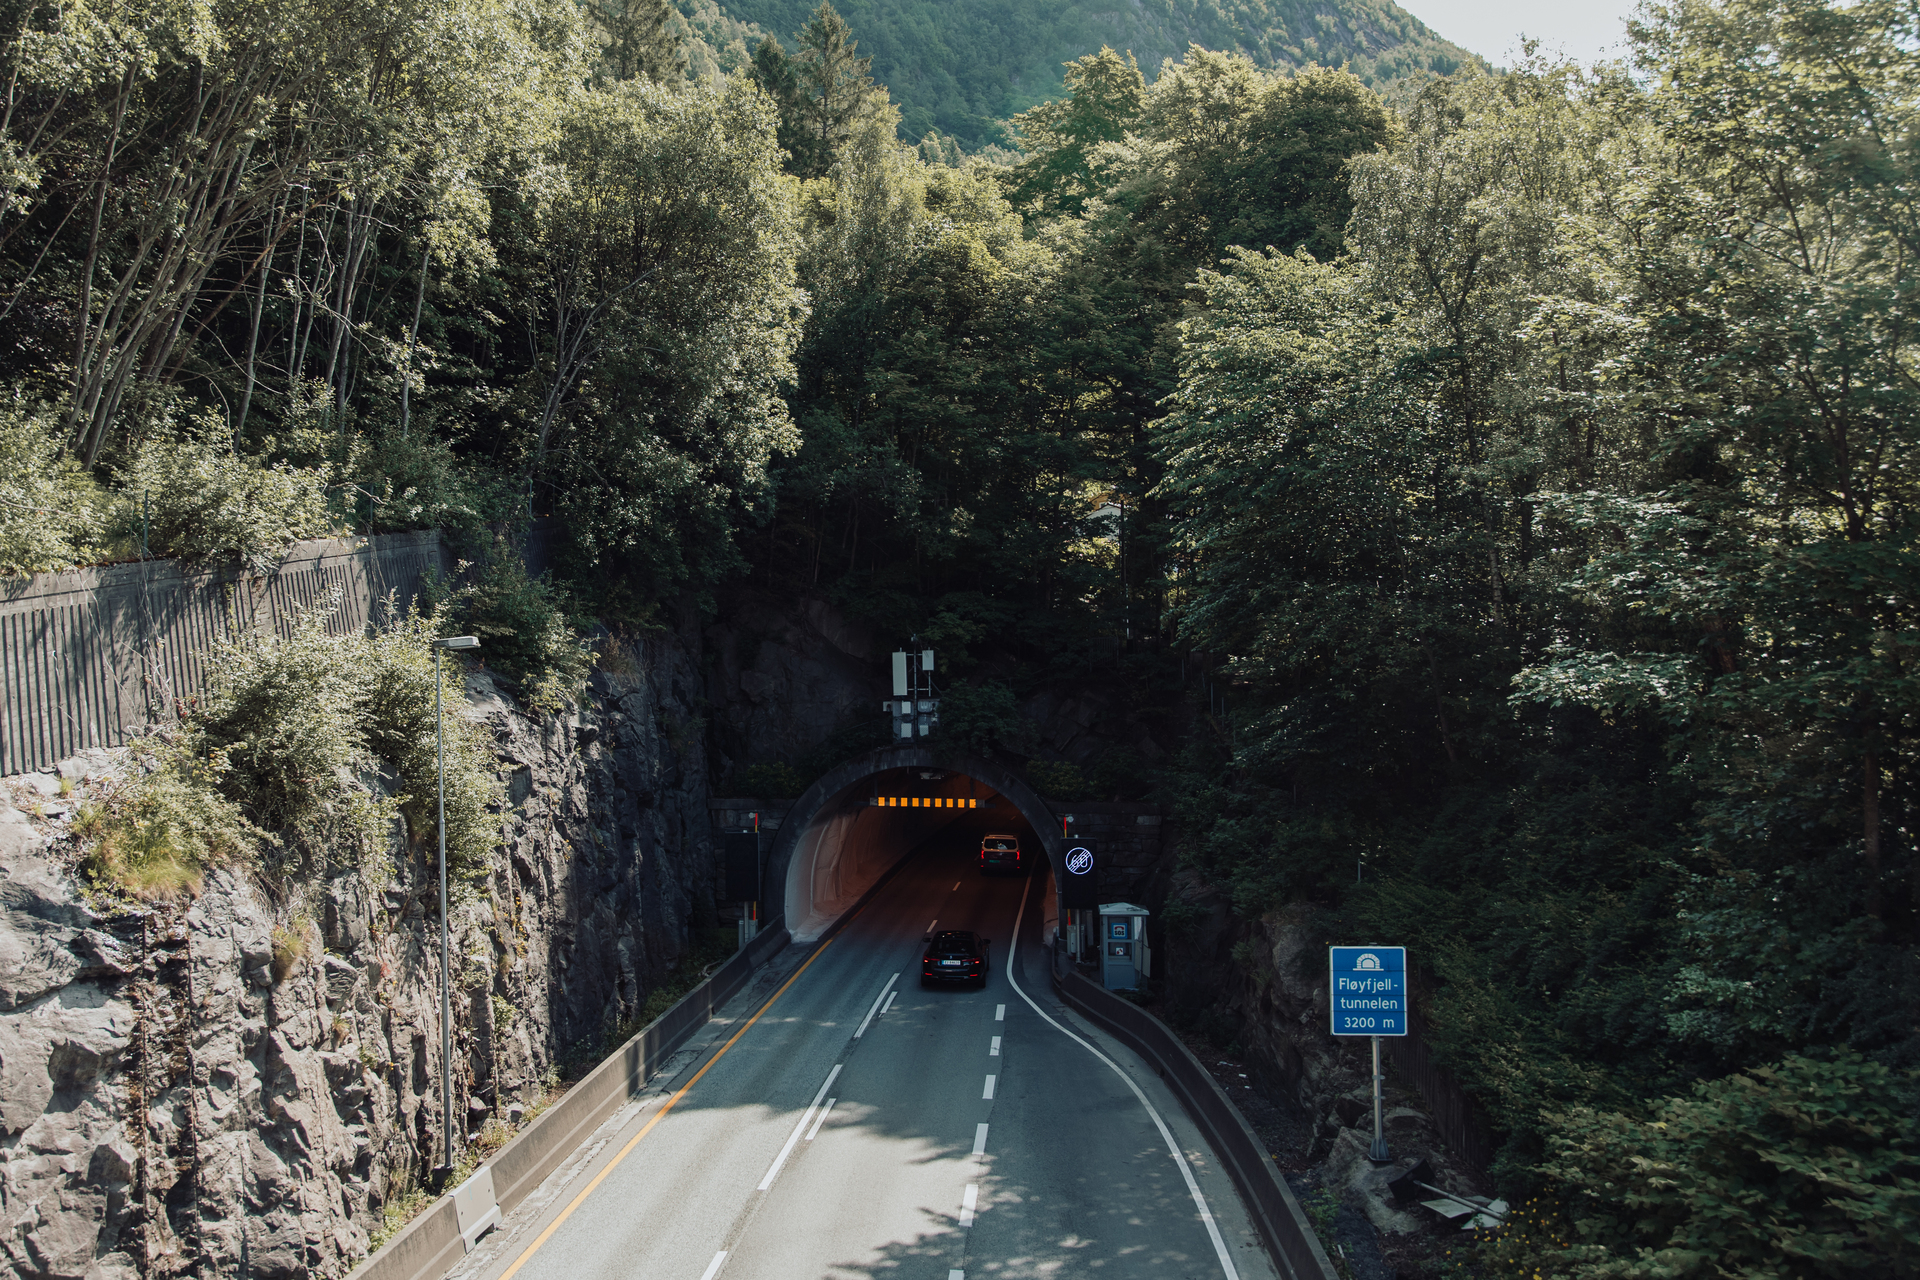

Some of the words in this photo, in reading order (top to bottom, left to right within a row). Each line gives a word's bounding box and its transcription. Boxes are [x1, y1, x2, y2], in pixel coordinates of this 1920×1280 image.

[1340, 997, 1398, 1009] tunnelen
[1344, 1017, 1375, 1028] 3200
[1383, 1018, 1395, 1028] m
